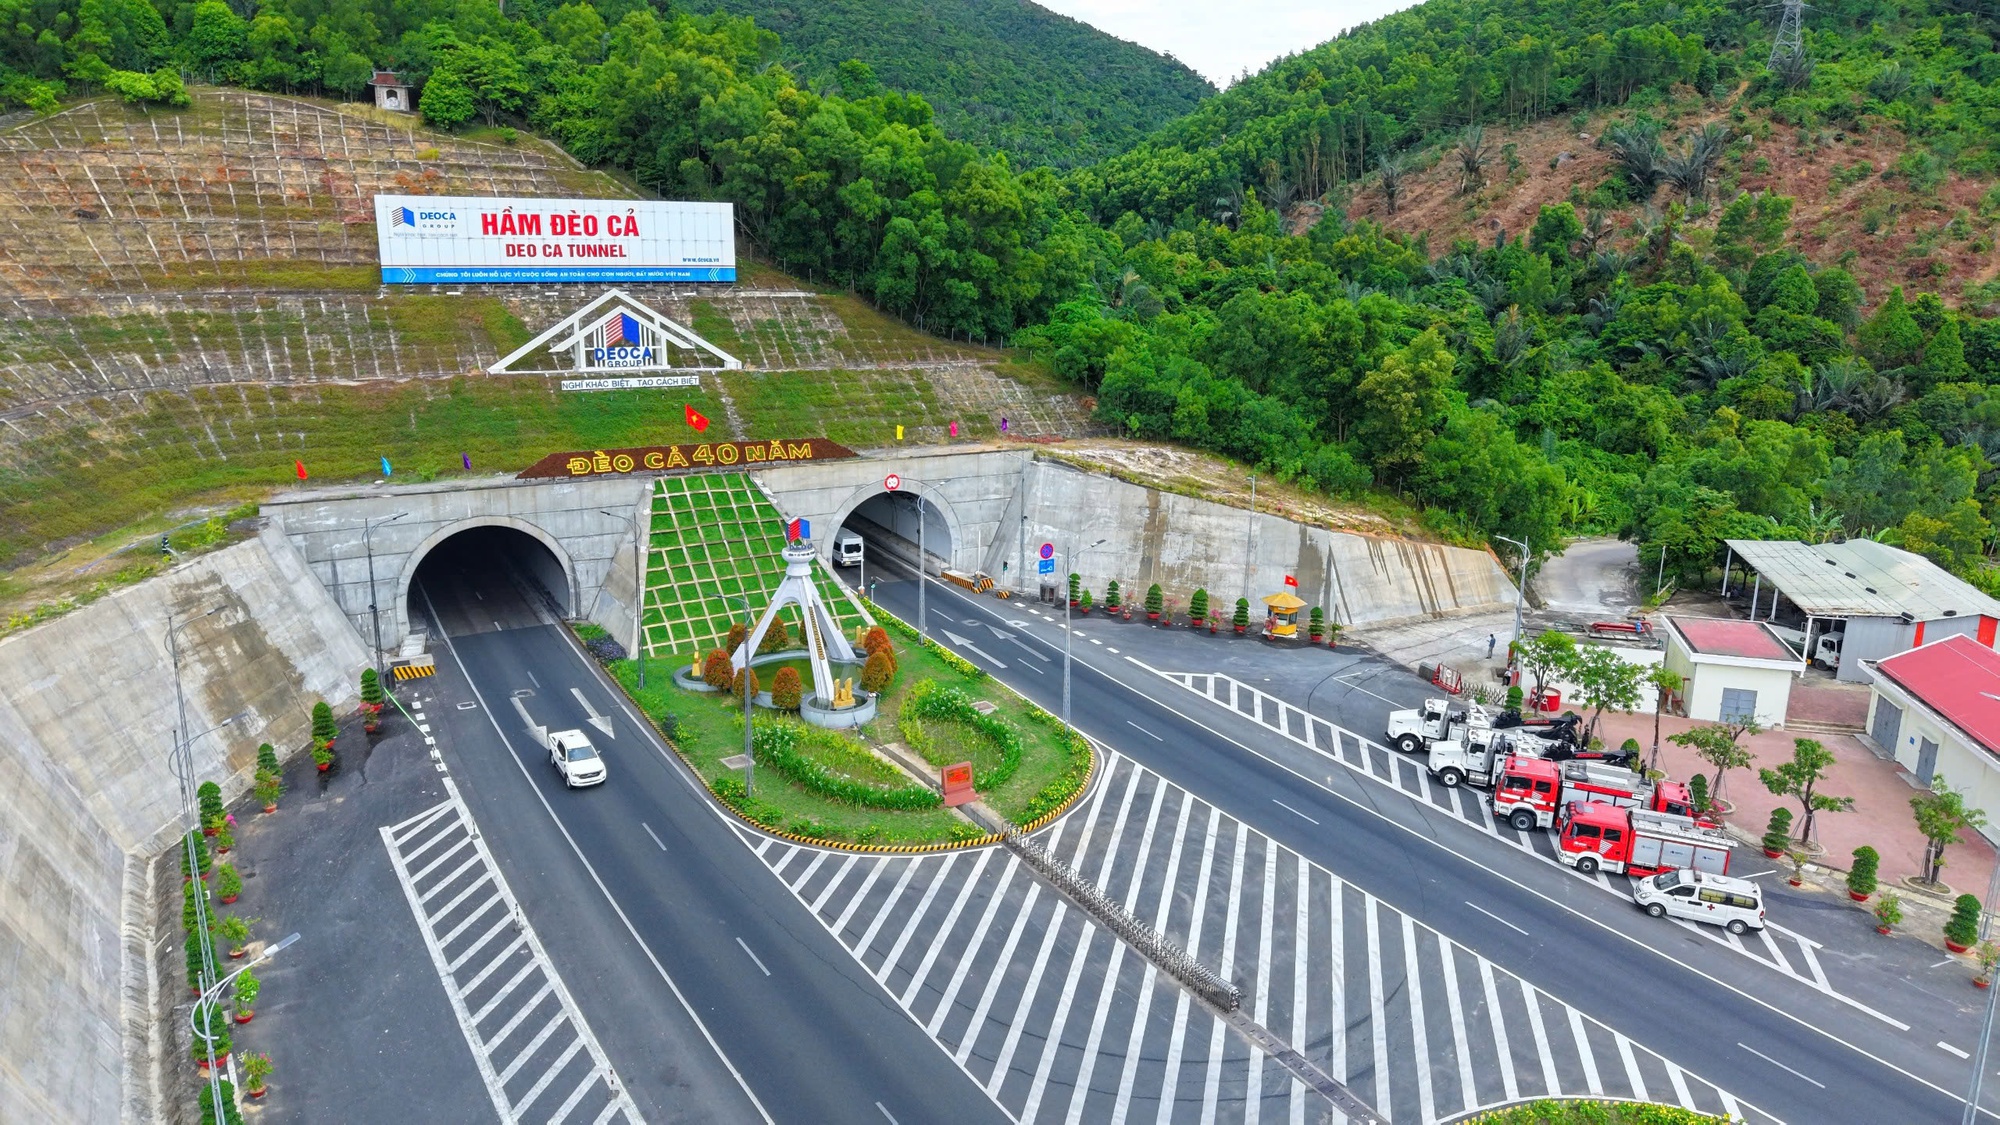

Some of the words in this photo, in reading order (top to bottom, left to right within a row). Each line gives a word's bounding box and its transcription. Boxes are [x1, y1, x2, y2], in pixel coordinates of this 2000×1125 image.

[420, 212, 456, 220] DEOCA
[480, 206, 542, 235] HẦM
[550, 210, 598, 236] ĐÈO
[607, 208, 640, 236] CẢ
[505, 244, 536, 257] DEO
[542, 244, 563, 257] CA
[567, 244, 627, 257] TUNNEL
[594, 347, 652, 360] DEOCA
[585, 379, 609, 388] KHÁC
[656, 377, 678, 385] CÁCH
[681, 376, 698, 385] BIỆT
[566, 450, 634, 474] ĐÈO
[644, 446, 689, 469] CẢ
[692, 443, 738, 464] 40
[746, 440, 812, 462] NĂM
